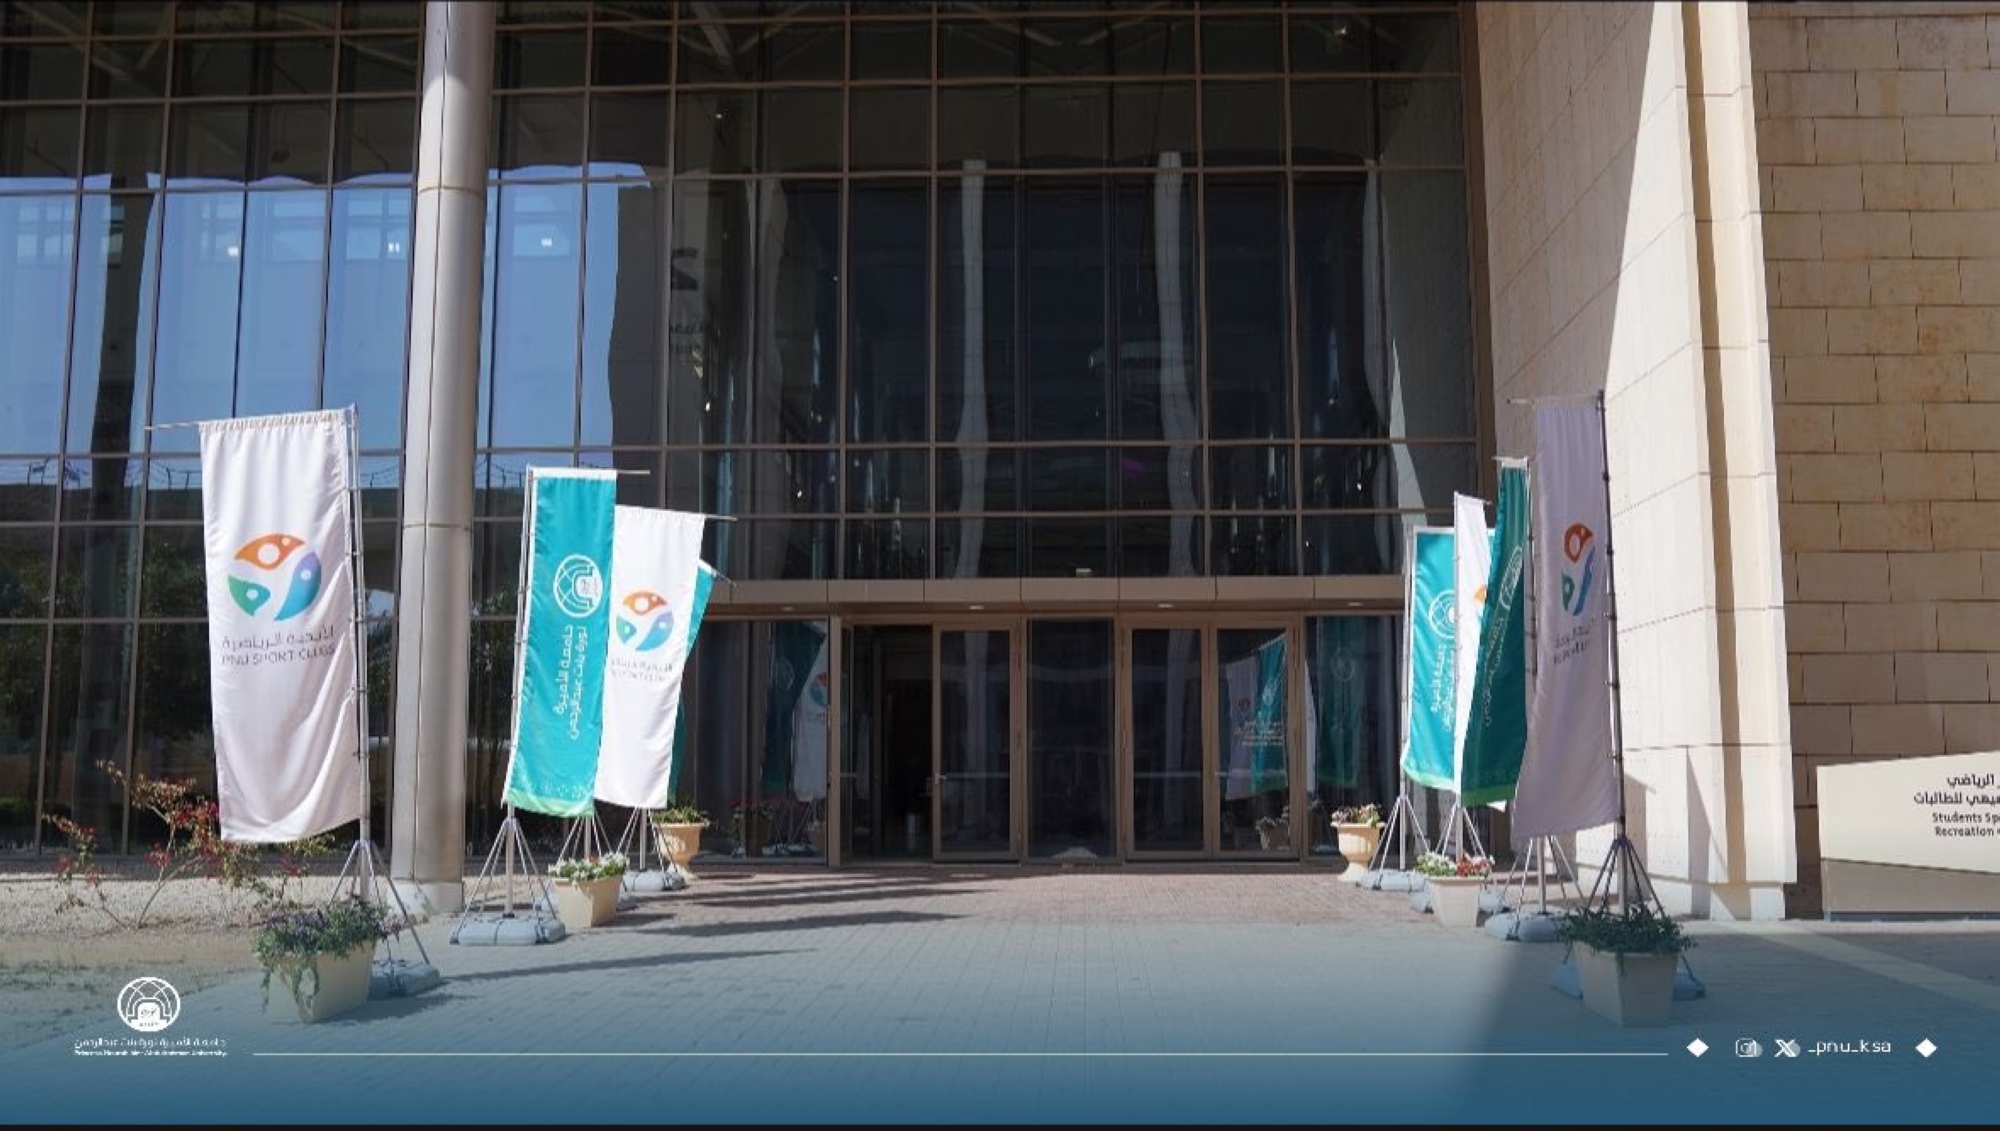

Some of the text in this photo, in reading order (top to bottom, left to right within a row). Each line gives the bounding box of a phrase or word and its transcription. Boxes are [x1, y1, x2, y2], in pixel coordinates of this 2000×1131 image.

[252, 648, 294, 665] SPORT
[552, 624, 574, 715] جامعة الأميرة
[1946, 773, 1995, 789] الرياضي
[1913, 791, 1963, 807] للطالبات
[1932, 811, 1982, 823] Students
[1935, 826, 1995, 837] Recreation
